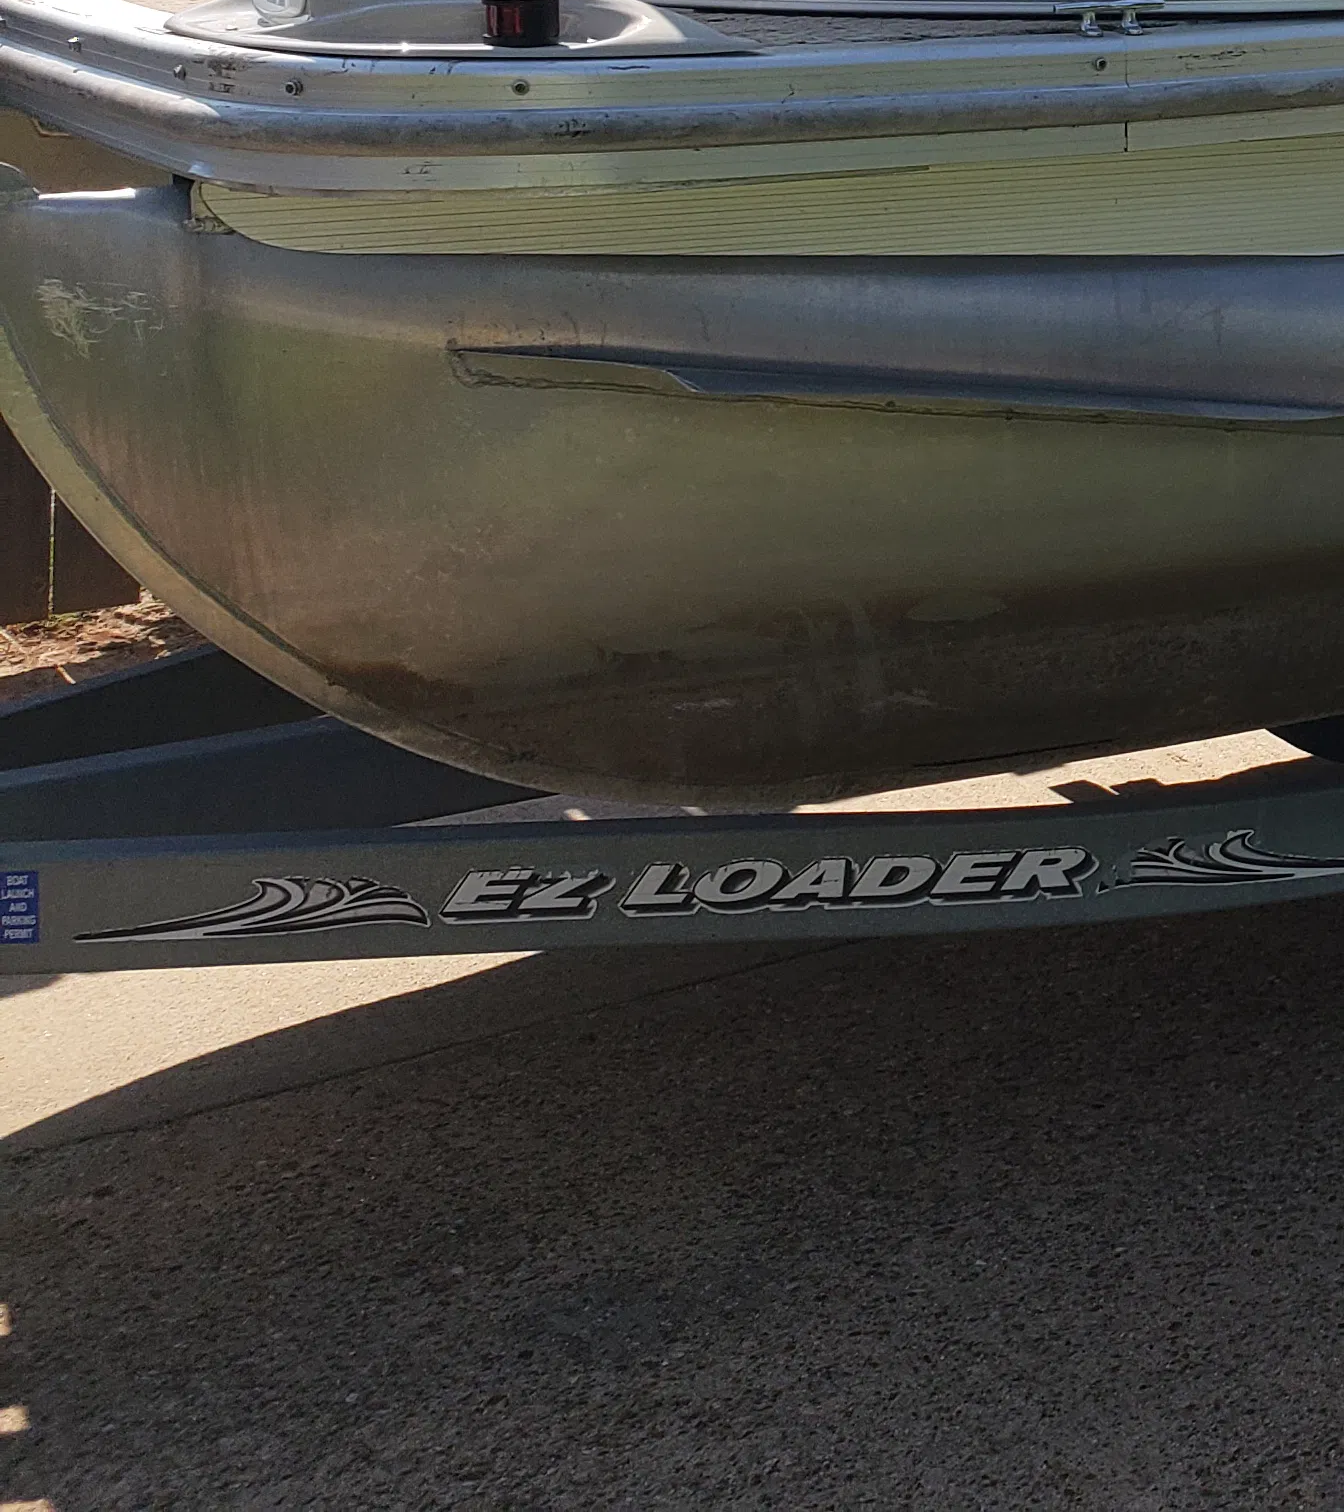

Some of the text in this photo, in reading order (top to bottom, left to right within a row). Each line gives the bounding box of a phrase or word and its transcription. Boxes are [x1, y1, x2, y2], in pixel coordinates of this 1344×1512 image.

[6, 875, 28, 886] BOAT
[439, 845, 1099, 924] EZ LOADER
